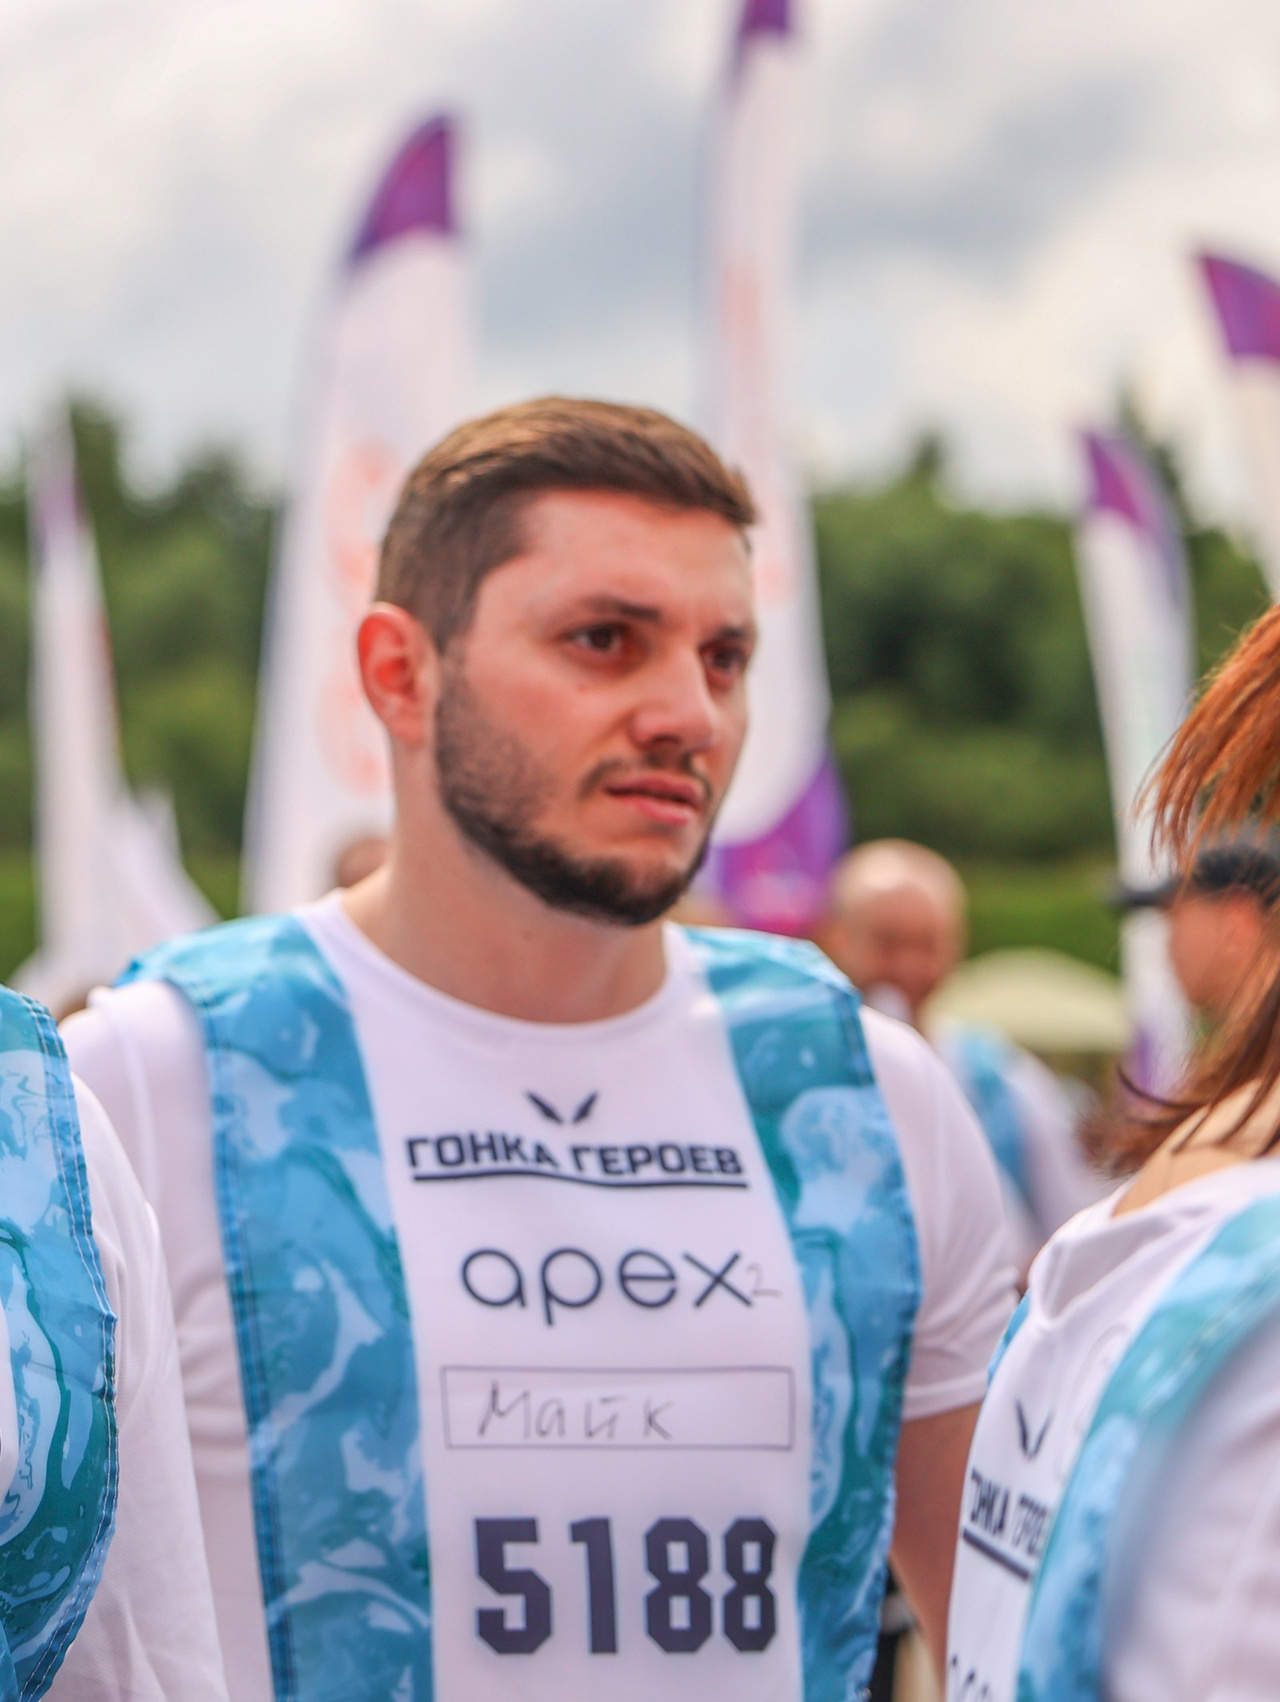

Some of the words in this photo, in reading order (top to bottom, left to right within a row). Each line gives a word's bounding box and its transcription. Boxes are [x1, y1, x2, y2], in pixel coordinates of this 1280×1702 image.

[406, 1133, 560, 1169] ГОНКА
[568, 1142, 744, 1176] ГЕРОЕВ
[461, 1247, 754, 1327] apex
[477, 1379, 673, 1441] Майк
[473, 1516, 777, 1655] 5188
